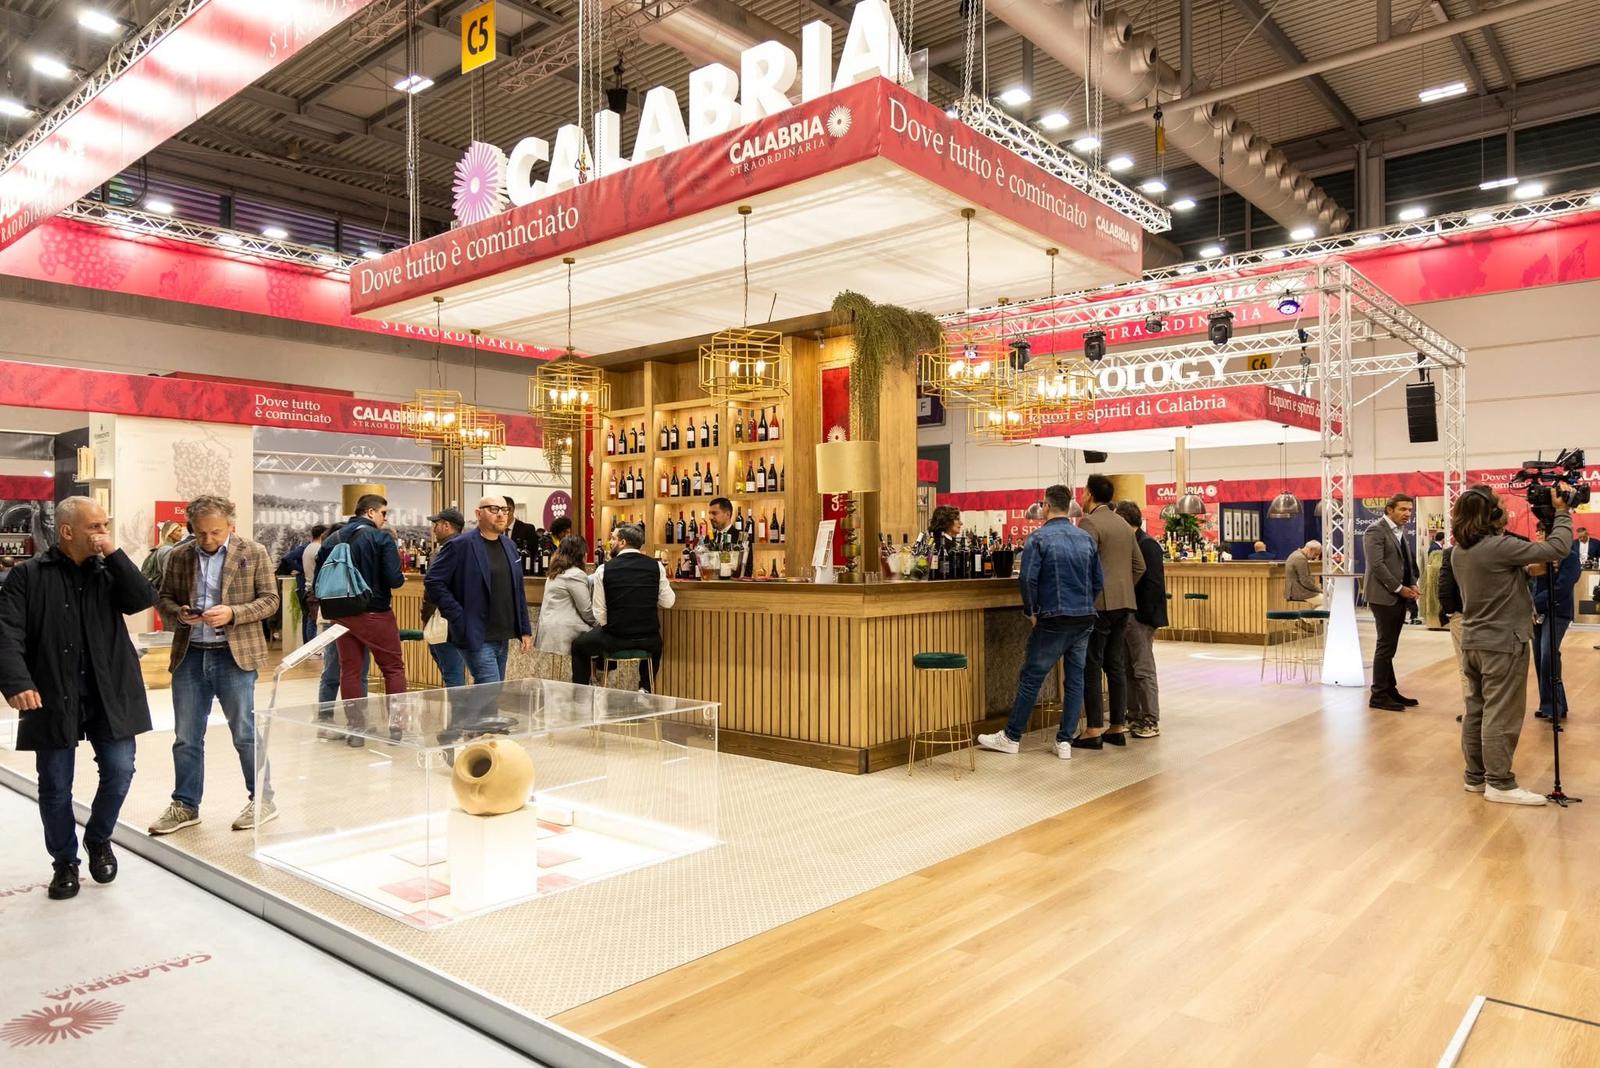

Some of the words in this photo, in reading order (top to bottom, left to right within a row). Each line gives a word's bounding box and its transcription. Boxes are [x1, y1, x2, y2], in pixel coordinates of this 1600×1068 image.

[467, 15, 489, 55] C5
[506, 0, 914, 206] CALABRIA
[729, 115, 825, 164] CALABRIA
[730, 138, 825, 176] STRAORDINARIA
[889, 97, 944, 154] Dove
[949, 135, 991, 180] tutto
[995, 157, 1005, 186] è
[1009, 174, 1087, 229] cominciato
[1096, 215, 1131, 245] CALABRIA
[361, 263, 401, 294] Dove
[406, 250, 447, 281] tutto
[451, 240, 461, 265] è
[466, 206, 579, 261] cominciato
[1251, 357, 1267, 371] C6
[255, 394, 288, 408] Dove
[292, 397, 320, 412] tutto
[255, 407, 262, 417] è
[265, 409, 332, 424] cominciato
[920, 402, 927, 413] F
[1075, 410, 1083, 421] e
[1087, 404, 1131, 424] spiriti
[1136, 400, 1151, 416] di
[1156, 394, 1226, 415] Calabria
[1268, 389, 1292, 412] Liquori
[1297, 399, 1315, 418] spiriti
[1481, 473, 1507, 481] Dove
[174, 507, 185, 515] Es
[256, 509, 319, 530] ungo
[45, 954, 212, 1001] CALABRIA
